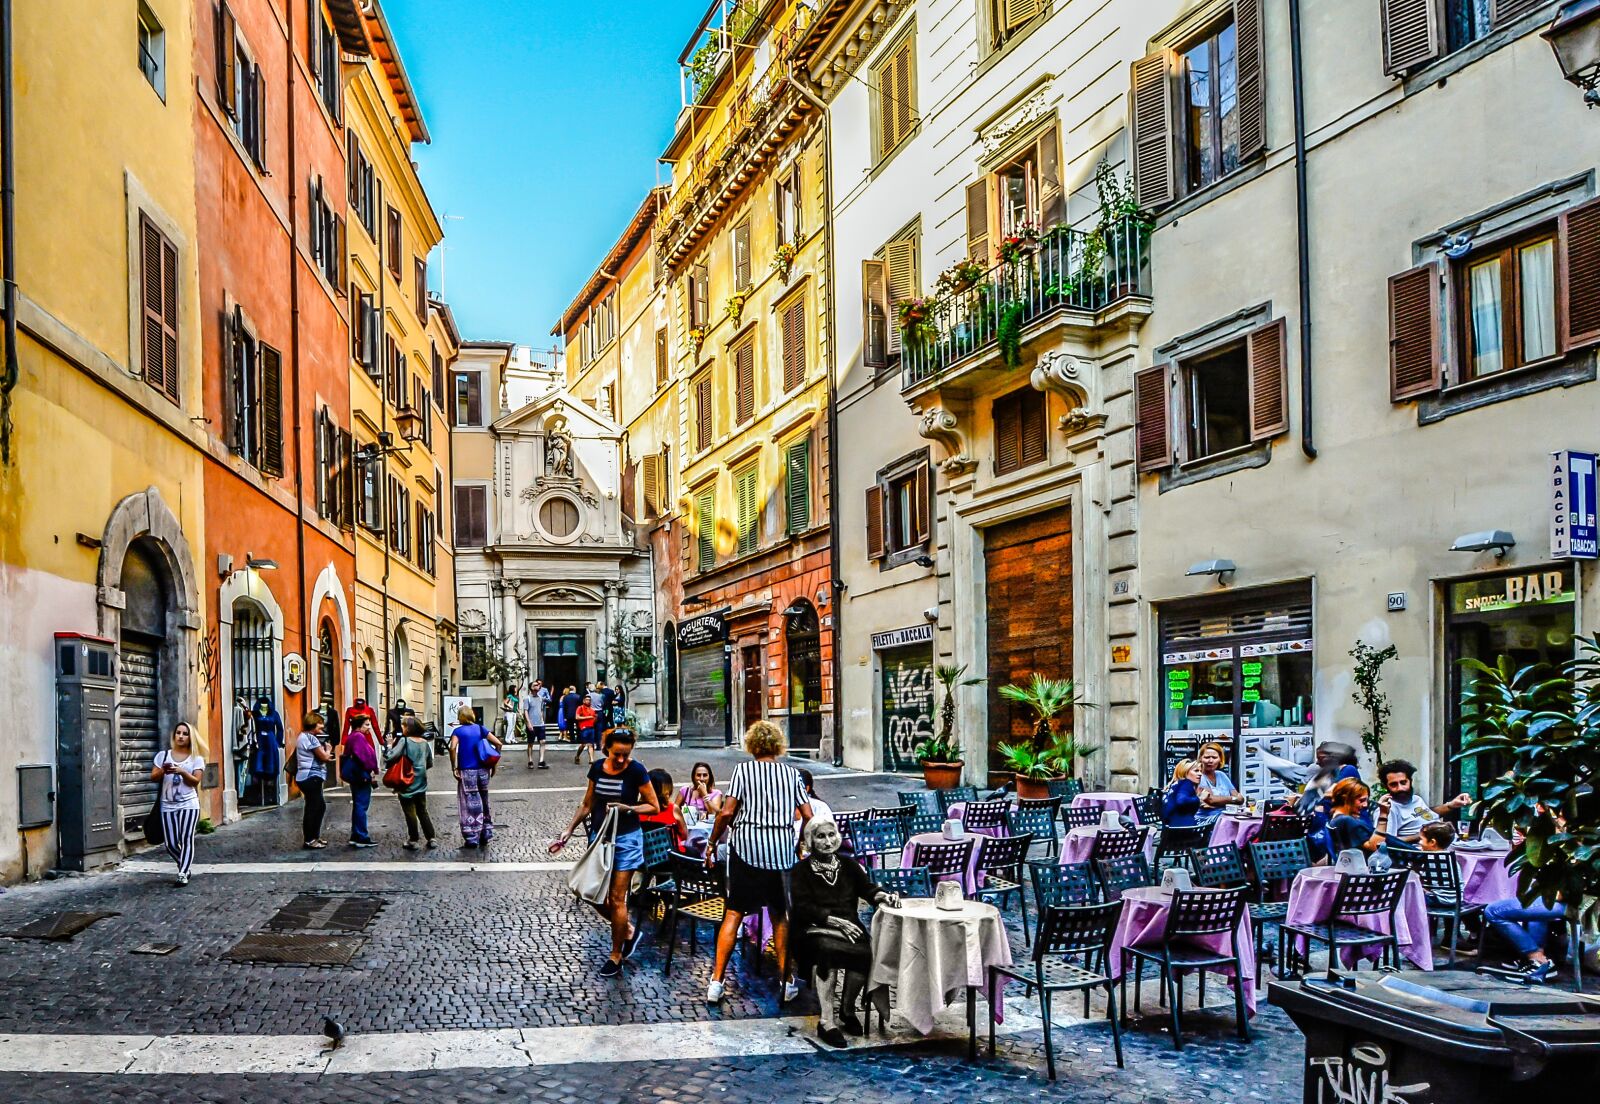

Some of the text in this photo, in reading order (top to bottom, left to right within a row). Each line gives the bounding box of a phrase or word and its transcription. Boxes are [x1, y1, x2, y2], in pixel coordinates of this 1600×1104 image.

[1553, 453, 1565, 548] TABACCHI
[1570, 458, 1593, 526] T
[1570, 538, 1597, 553] TABACCHI
[1506, 572, 1563, 603] BAR
[1389, 596, 1403, 607] 90
[677, 616, 721, 641] YOGURTERIA
[872, 632, 895, 648] FILETTI
